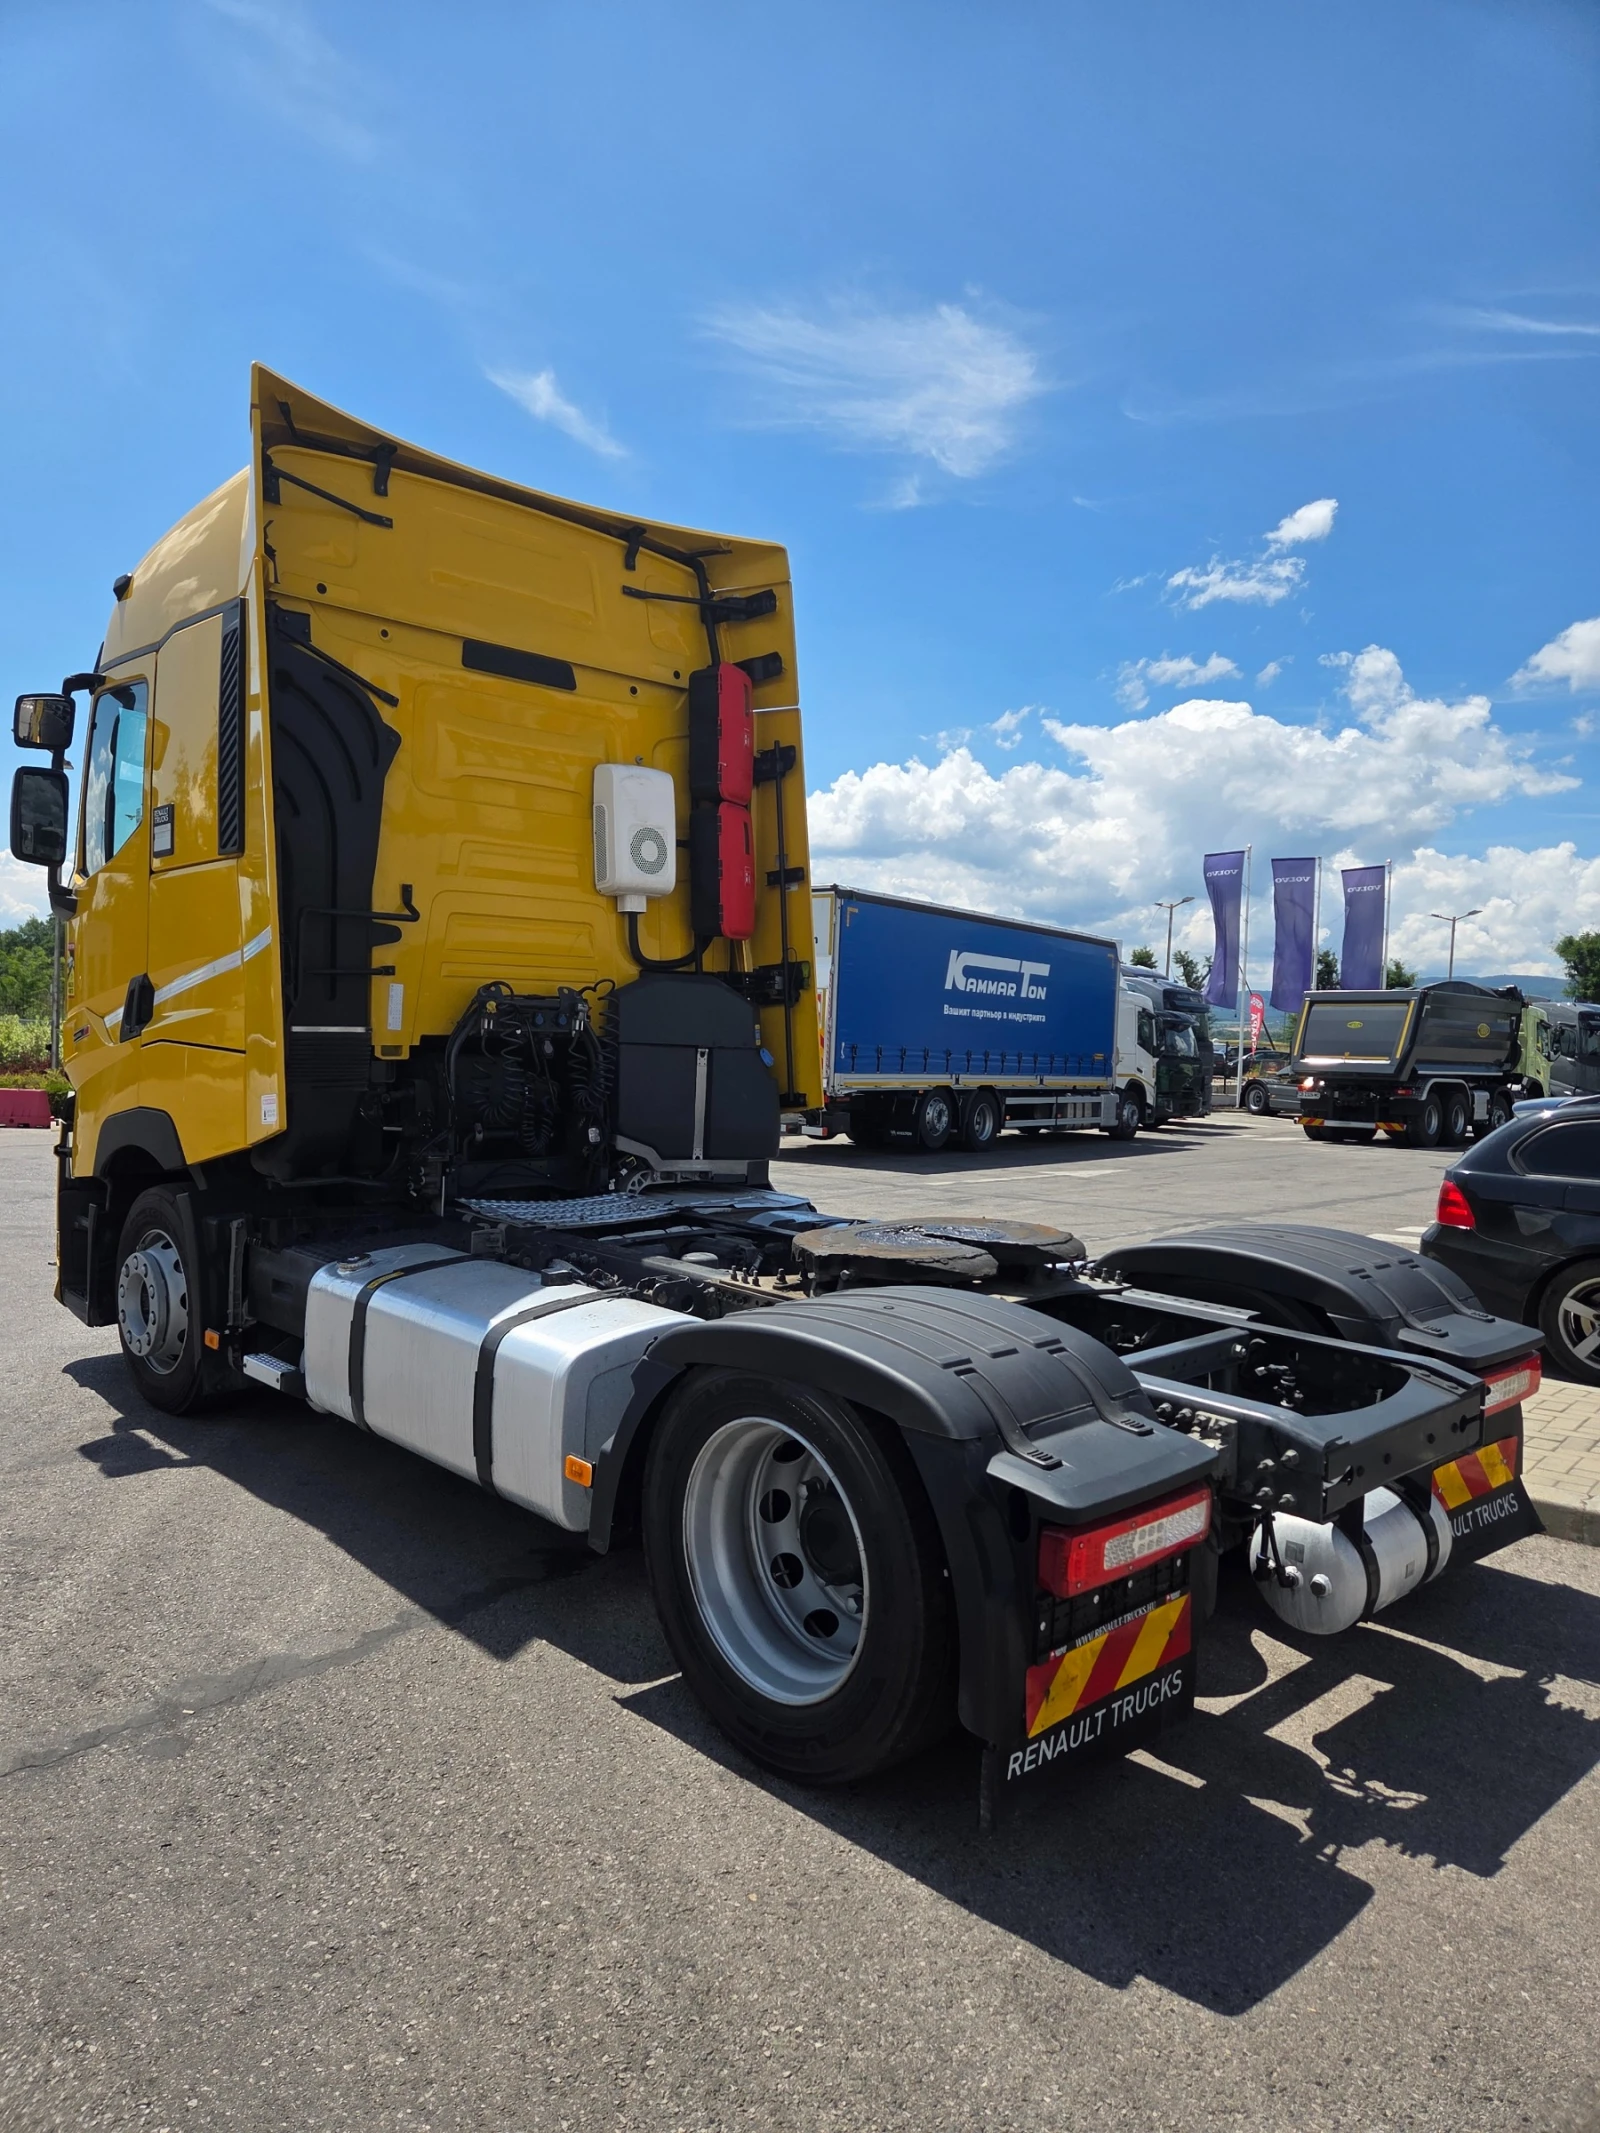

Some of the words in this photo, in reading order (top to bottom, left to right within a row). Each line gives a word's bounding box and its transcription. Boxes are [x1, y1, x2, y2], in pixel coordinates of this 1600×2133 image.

[943, 1004, 970, 1017] Вашият
[971, 1009, 1002, 1021] партньор
[1008, 1012, 1046, 1023] индустрията
[1475, 1492, 1519, 1527] TRUCKS
[1007, 1708, 1106, 1781] RENAULT
[1111, 1669, 1183, 1727] TRUCKS
